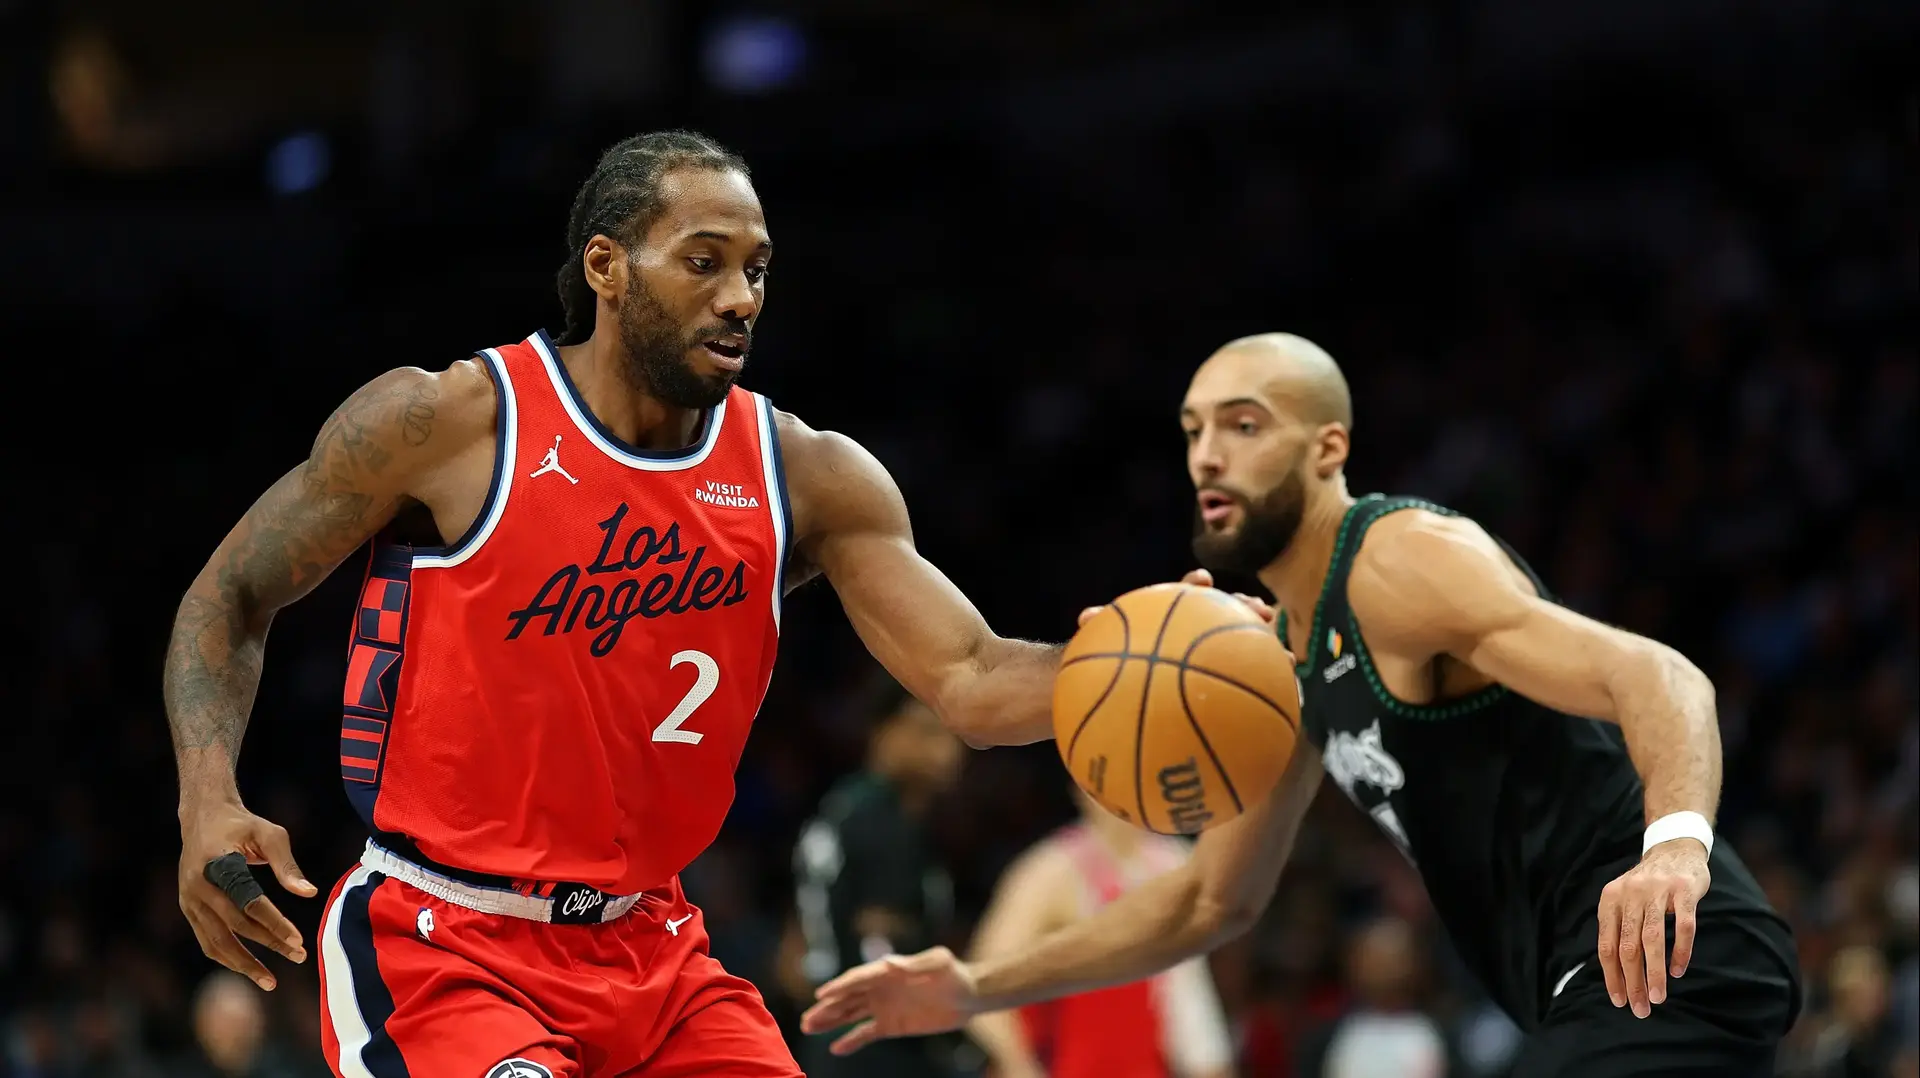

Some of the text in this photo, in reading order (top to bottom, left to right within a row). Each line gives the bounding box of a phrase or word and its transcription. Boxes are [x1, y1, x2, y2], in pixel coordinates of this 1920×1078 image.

[695, 488, 759, 508] RWANDA
[705, 480, 743, 496] VISIT
[587, 502, 687, 576] Los
[504, 546, 749, 657] Angeles
[652, 649, 720, 746] 2
[1157, 756, 1214, 834] Wil
[562, 889, 604, 916] Clips
